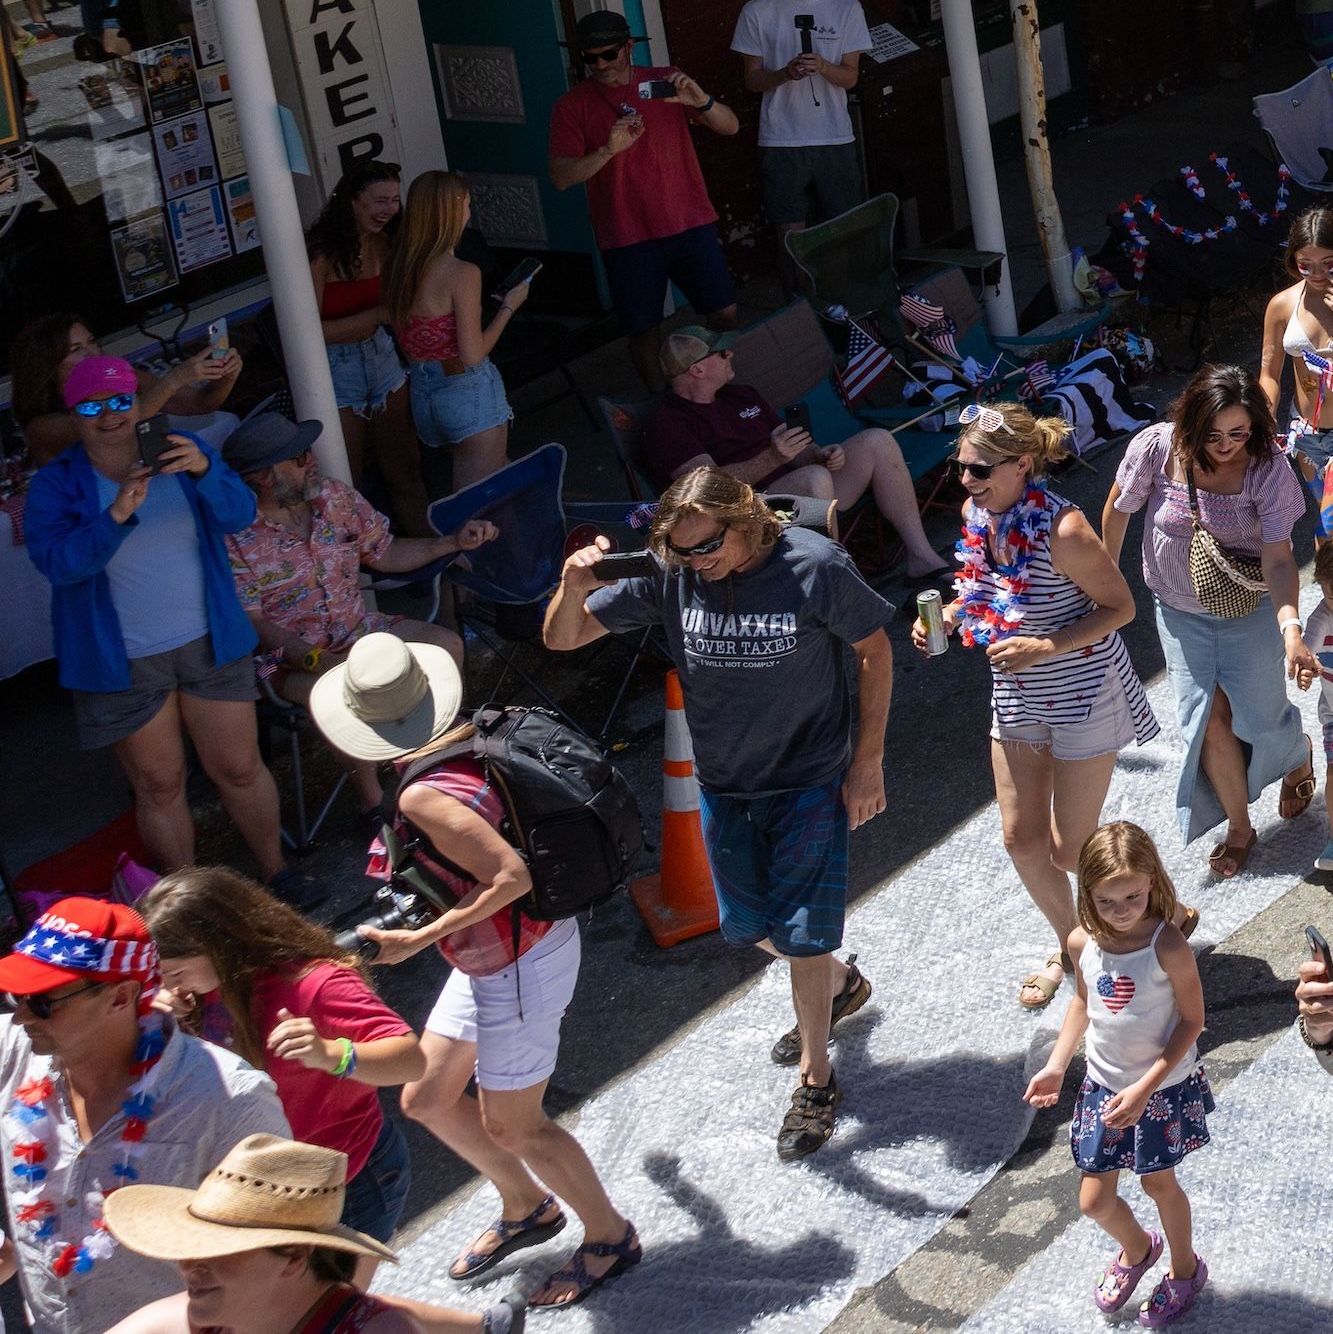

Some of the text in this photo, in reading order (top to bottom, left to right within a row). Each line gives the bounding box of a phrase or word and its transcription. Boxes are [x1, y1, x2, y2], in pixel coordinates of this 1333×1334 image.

[681, 608, 798, 637] UNVAXXED
[695, 637, 737, 656] OVER
[741, 635, 798, 656] TAXED
[704, 659, 723, 668] WILL
[724, 660, 741, 668] NOT
[742, 660, 776, 669] COMPLY
